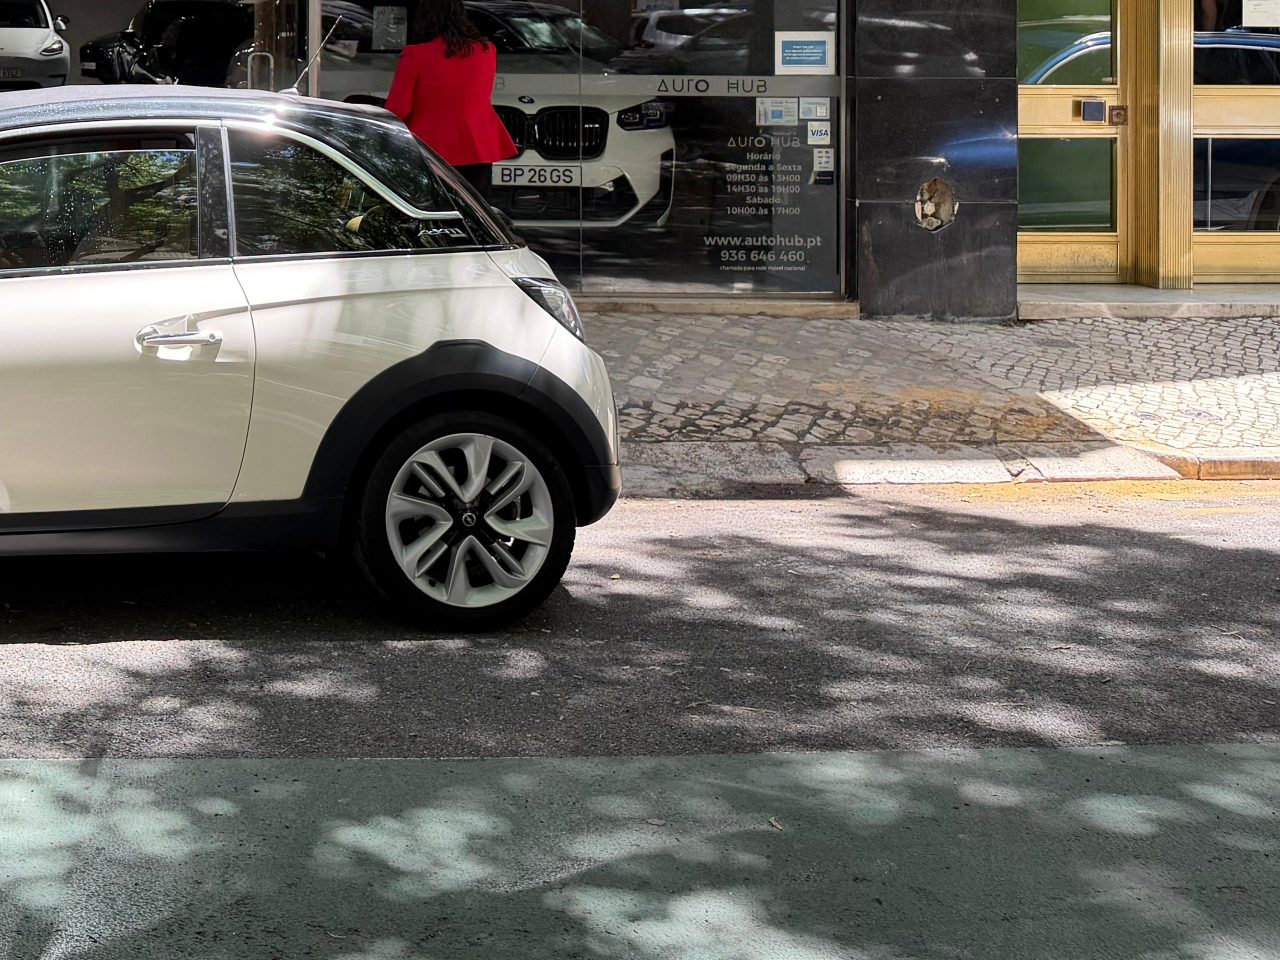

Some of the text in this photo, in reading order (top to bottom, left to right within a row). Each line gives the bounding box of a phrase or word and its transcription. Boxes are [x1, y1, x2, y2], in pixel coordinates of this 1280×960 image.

[657, 79, 767, 93] AUTO HUB
[728, 136, 800, 147] AUTO HUB
[747, 152, 780, 160] Horário
[726, 164, 766, 172] Segunda
[501, 168, 573, 183] BP 26 GS
[746, 195, 781, 204] Sábado
[726, 206, 756, 214] 10H00
[704, 235, 822, 248] www.autohub.pt
[721, 250, 804, 262] 936 646 460
